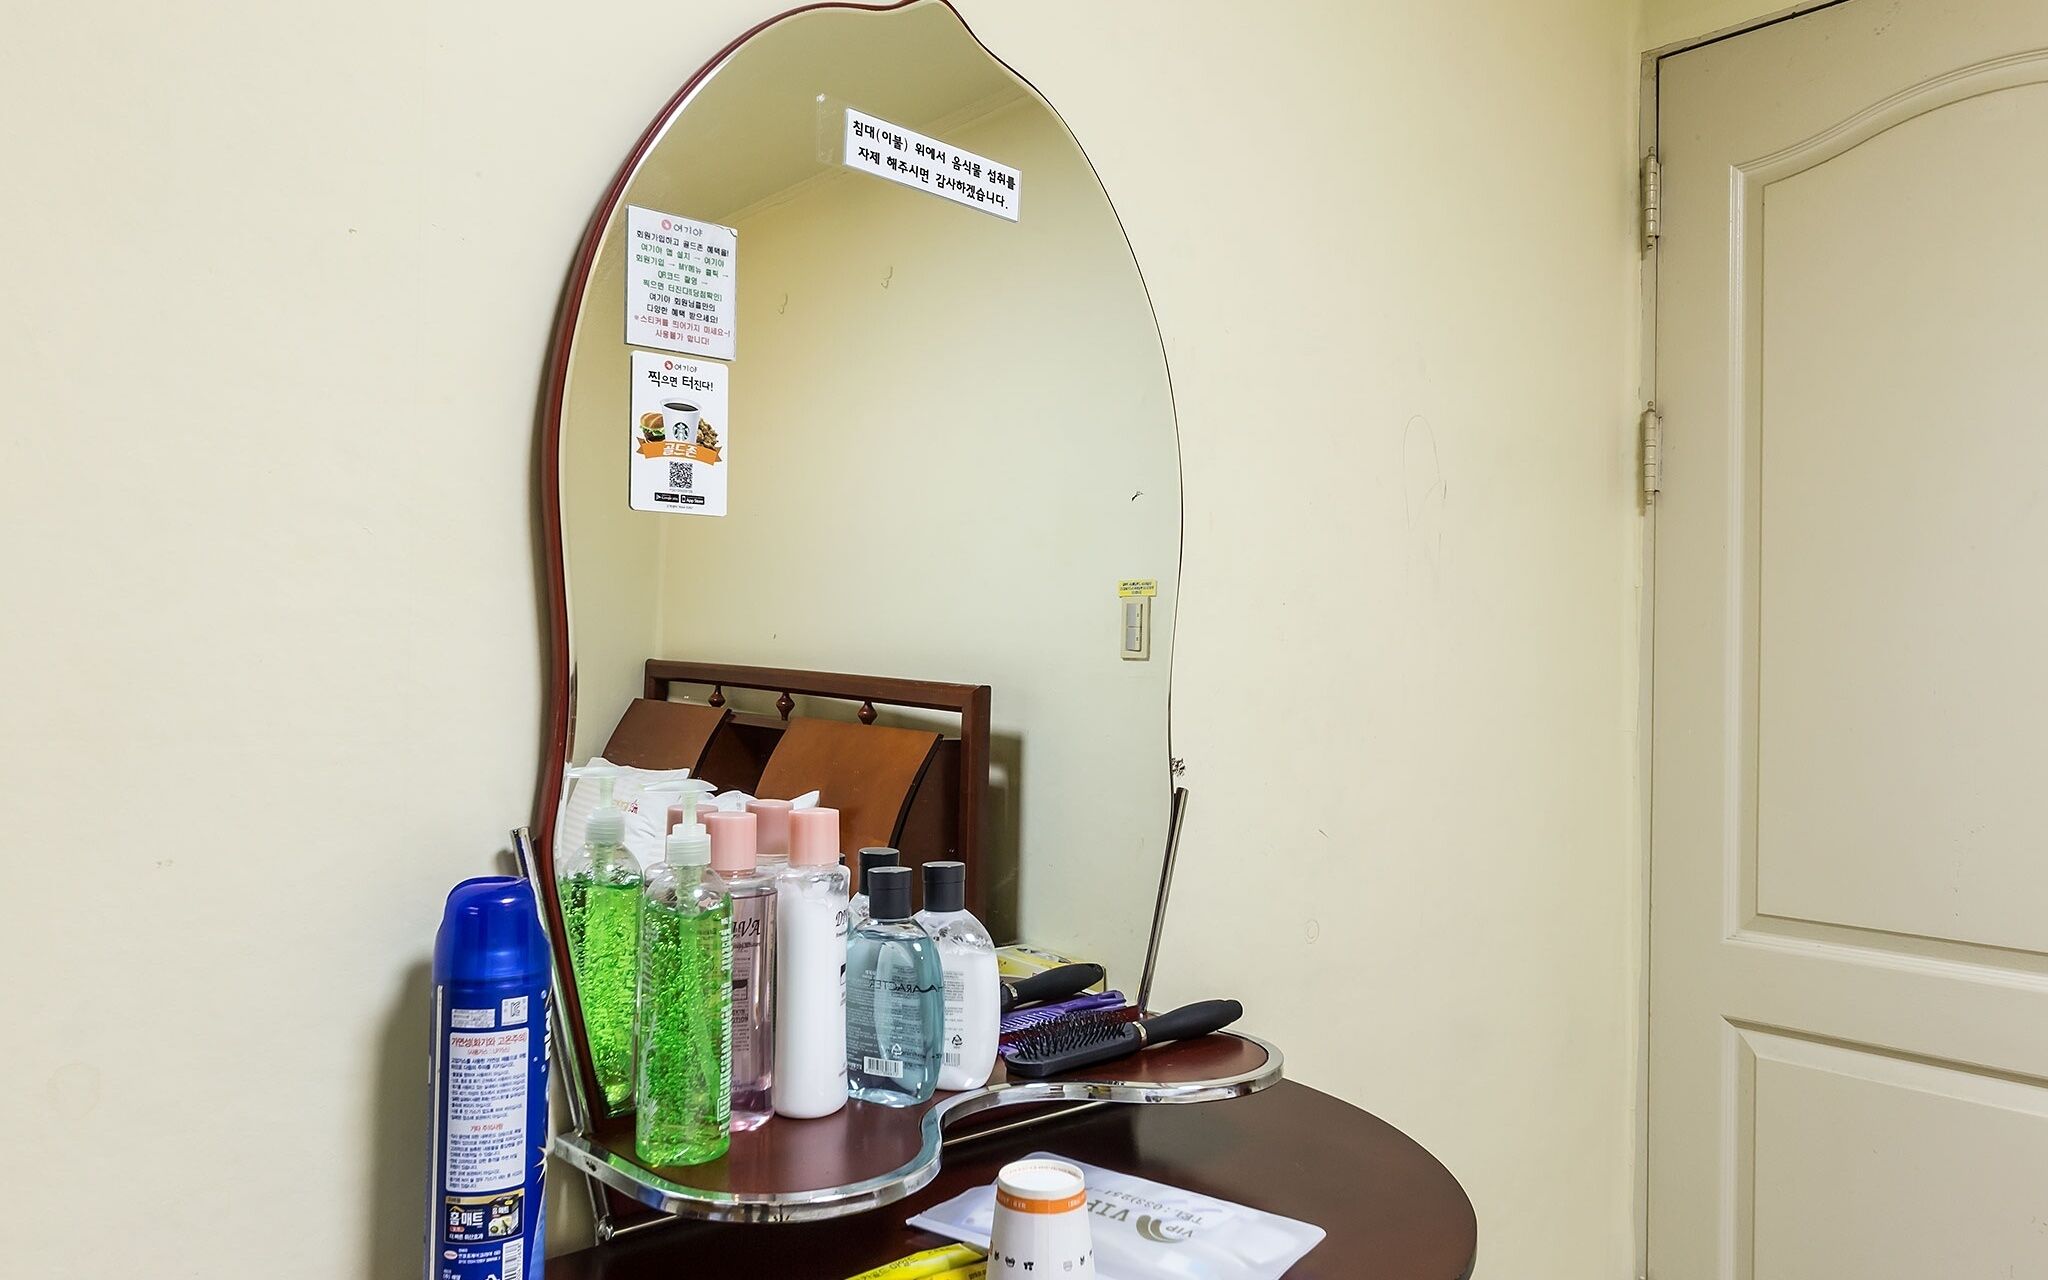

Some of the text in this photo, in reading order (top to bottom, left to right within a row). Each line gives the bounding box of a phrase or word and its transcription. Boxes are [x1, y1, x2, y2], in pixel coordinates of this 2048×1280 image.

[853, 120, 1016, 190] 침대(이불) 위에서 음식물 섭취를
[858, 146, 1009, 209] 자제 해주시면 감사하겠습니다.
[648, 371, 714, 392] 찍으면 터진다!
[663, 443, 698, 458] 골드존
[733, 917, 760, 937] IVA
[449, 1211, 484, 1226] 홈매트
[1166, 1226, 1193, 1238] VIP
